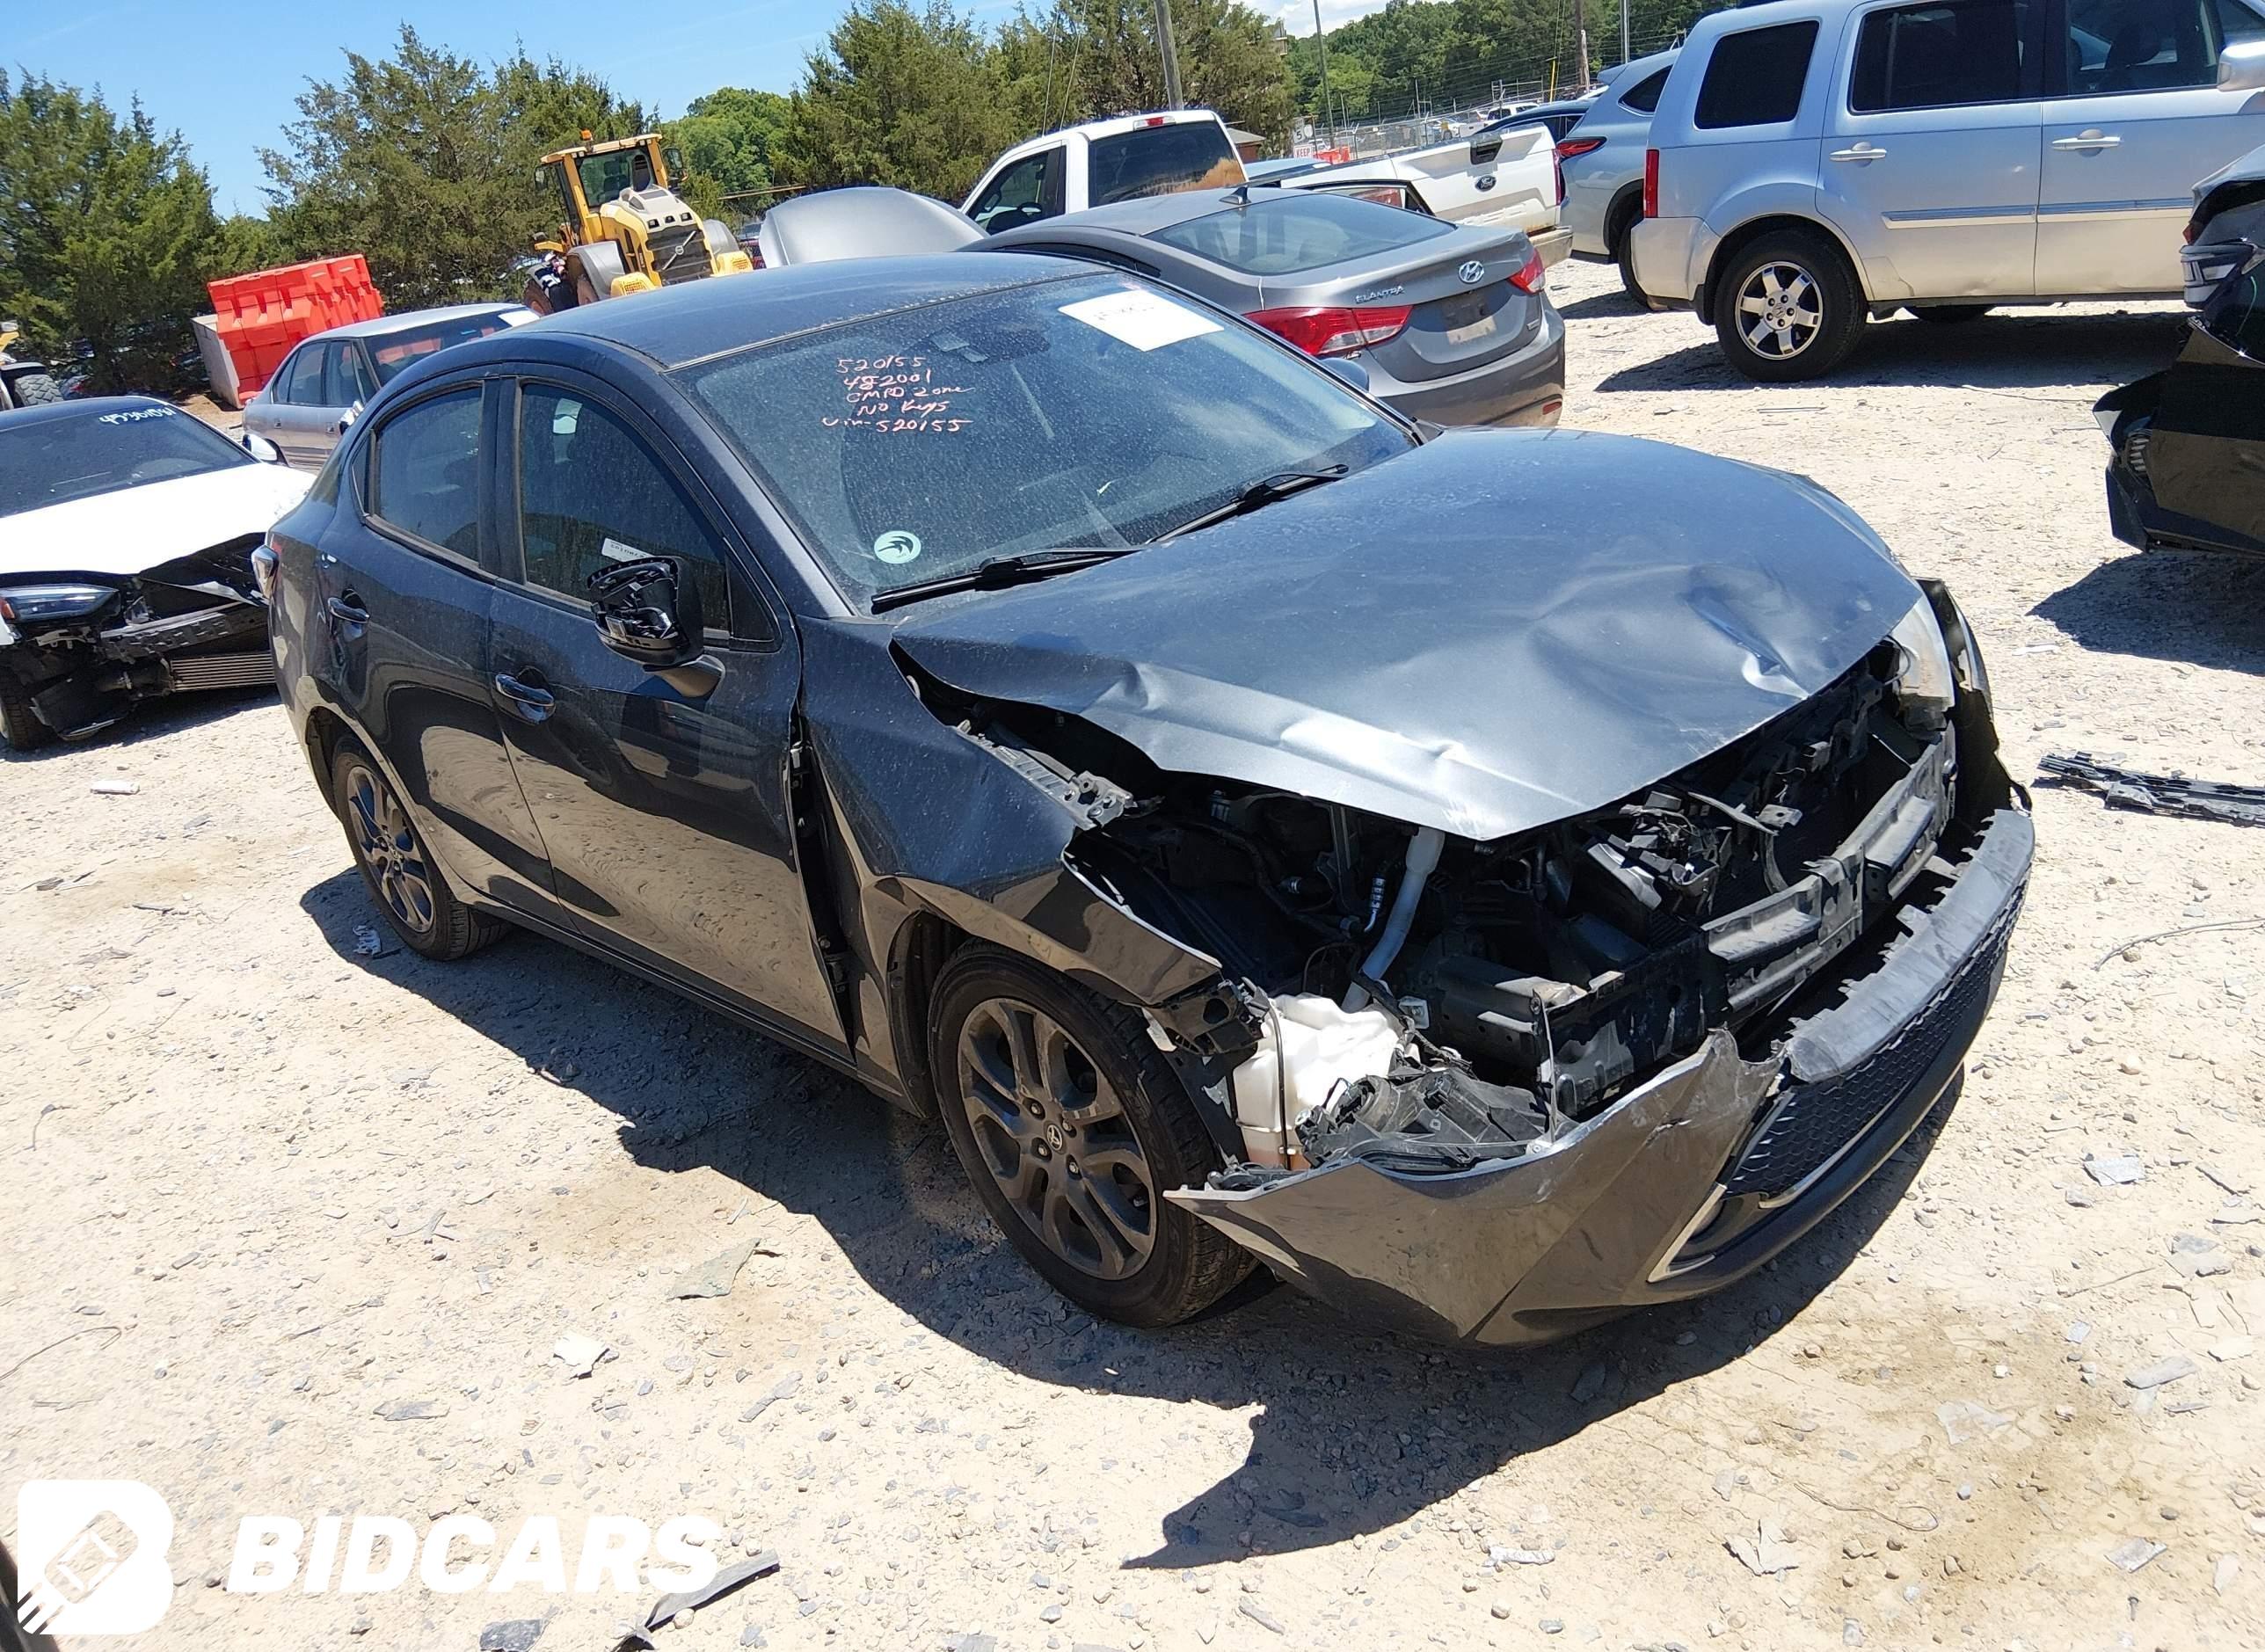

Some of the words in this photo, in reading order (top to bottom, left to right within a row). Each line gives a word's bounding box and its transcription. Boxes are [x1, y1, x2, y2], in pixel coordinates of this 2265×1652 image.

[1296, 148, 1311, 158] KEEP
[1355, 285, 1404, 303] ELANTRA
[836, 355, 927, 374] 520155
